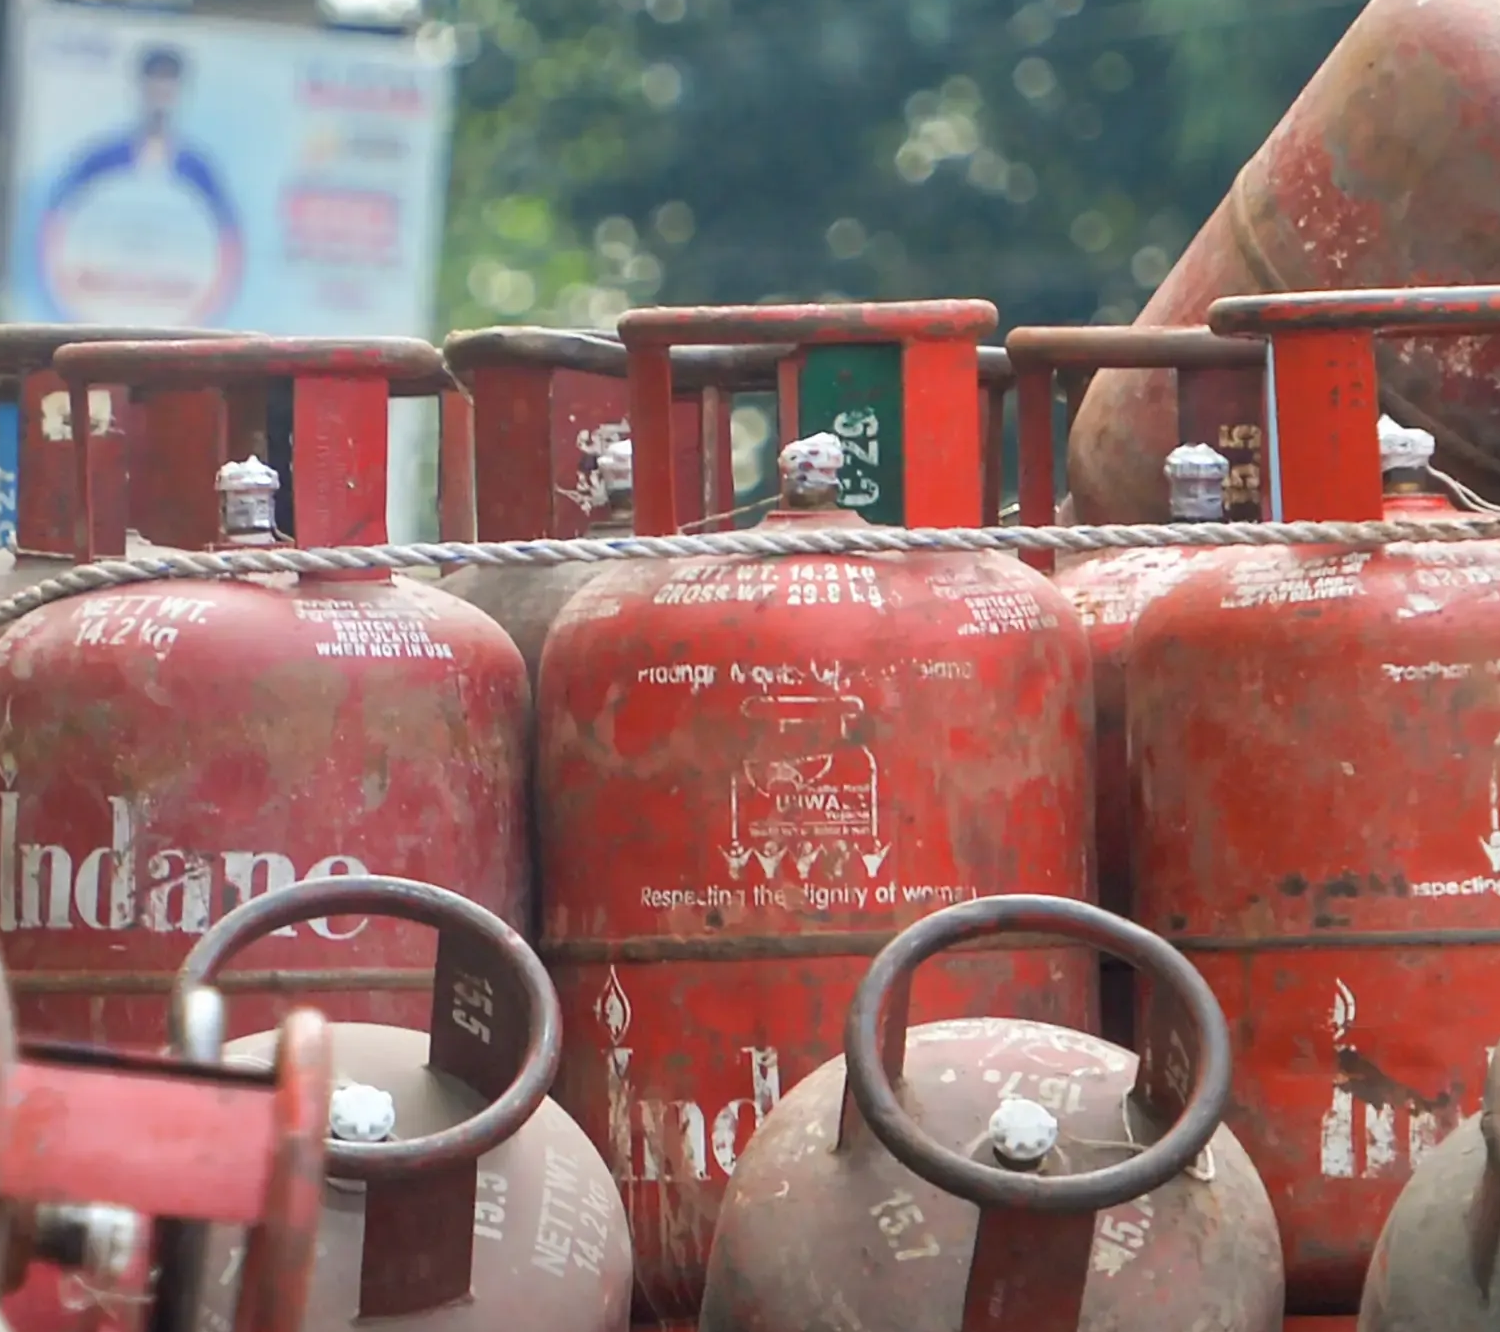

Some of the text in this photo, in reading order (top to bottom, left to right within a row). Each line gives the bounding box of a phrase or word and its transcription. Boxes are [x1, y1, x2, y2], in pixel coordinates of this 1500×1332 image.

[790, 562, 840, 581] 14.2
[73, 617, 138, 648] 14.2
[315, 641, 367, 658] WHEN
[370, 642, 402, 658] NOT
[405, 642, 423, 659] IN
[874, 881, 897, 904] of
